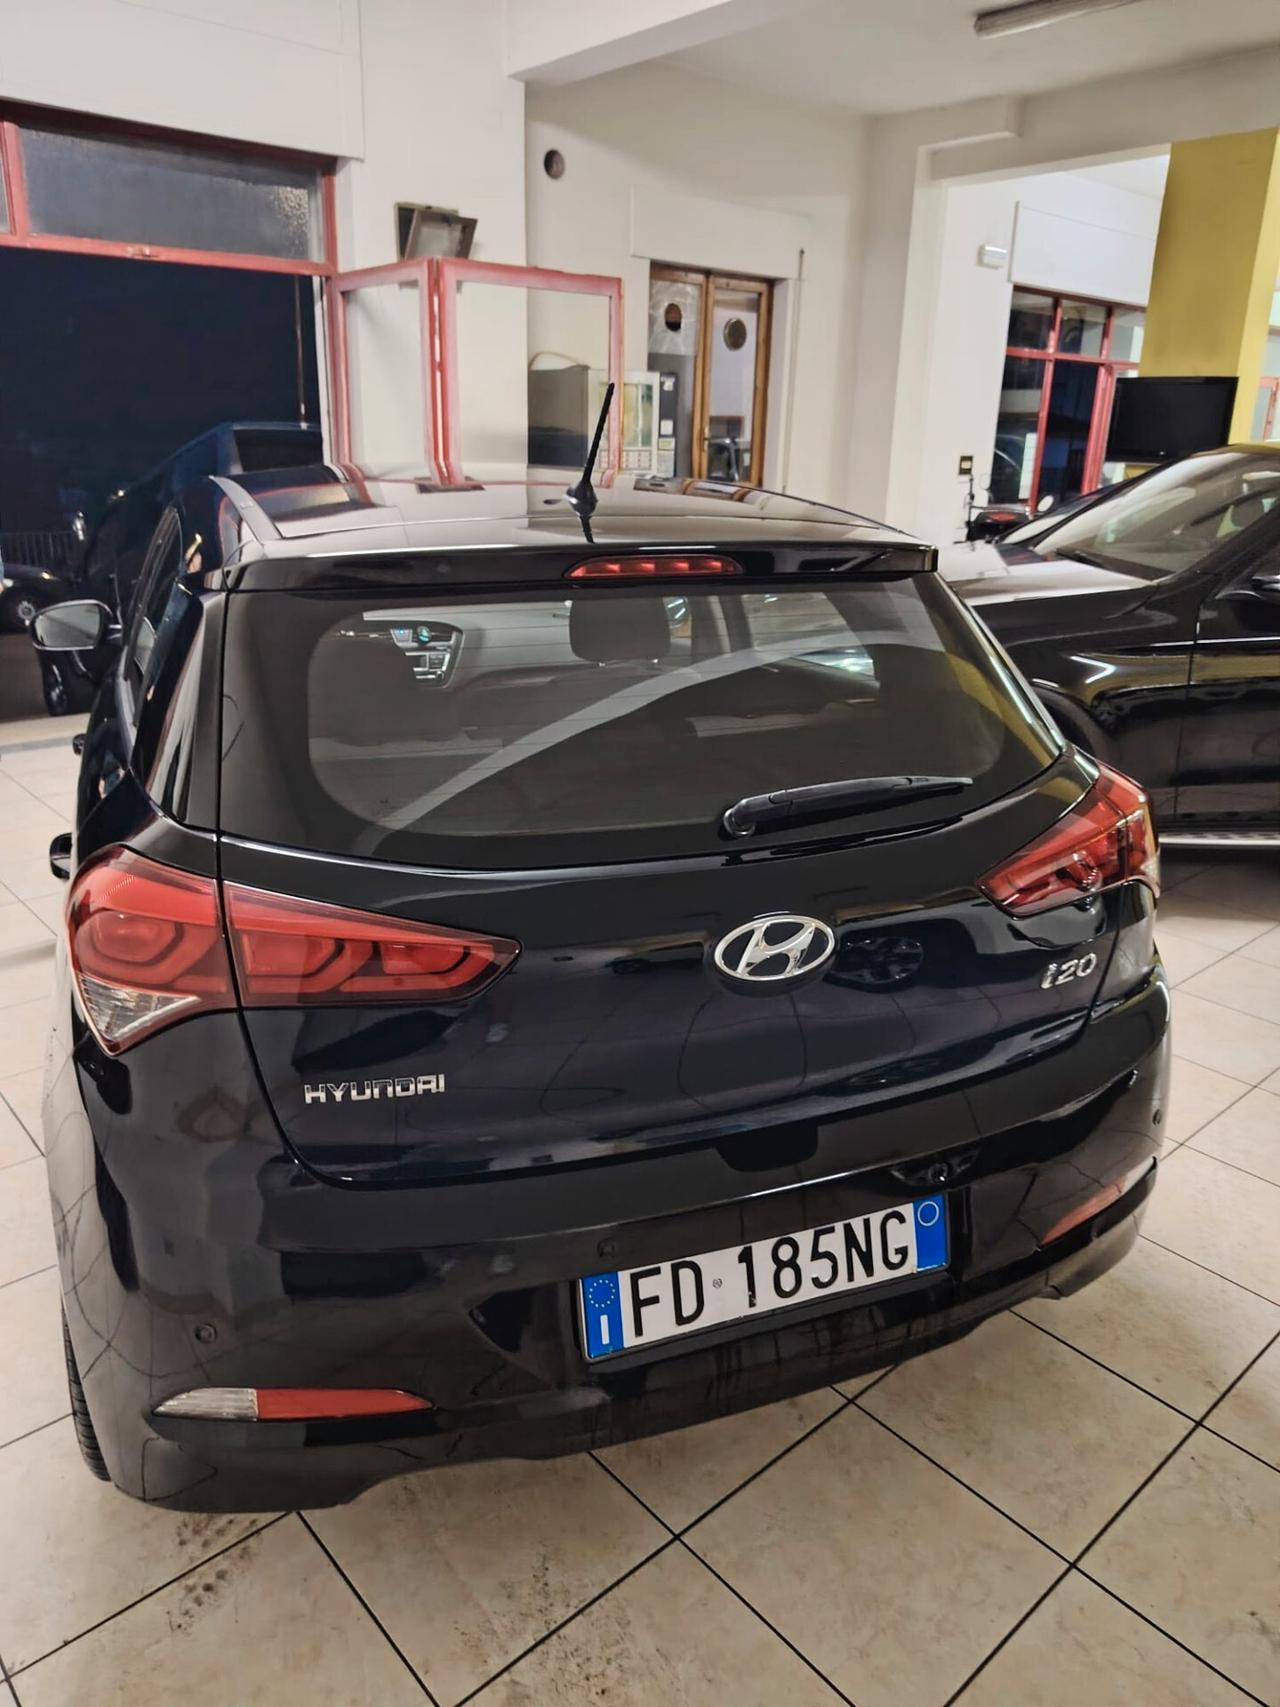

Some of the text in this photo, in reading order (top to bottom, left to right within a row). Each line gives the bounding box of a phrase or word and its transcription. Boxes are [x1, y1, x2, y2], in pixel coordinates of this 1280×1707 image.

[1040, 952, 1097, 989] i20
[304, 1073, 446, 1104] HYUNDAI
[630, 1210, 909, 1338] FD 185NG
